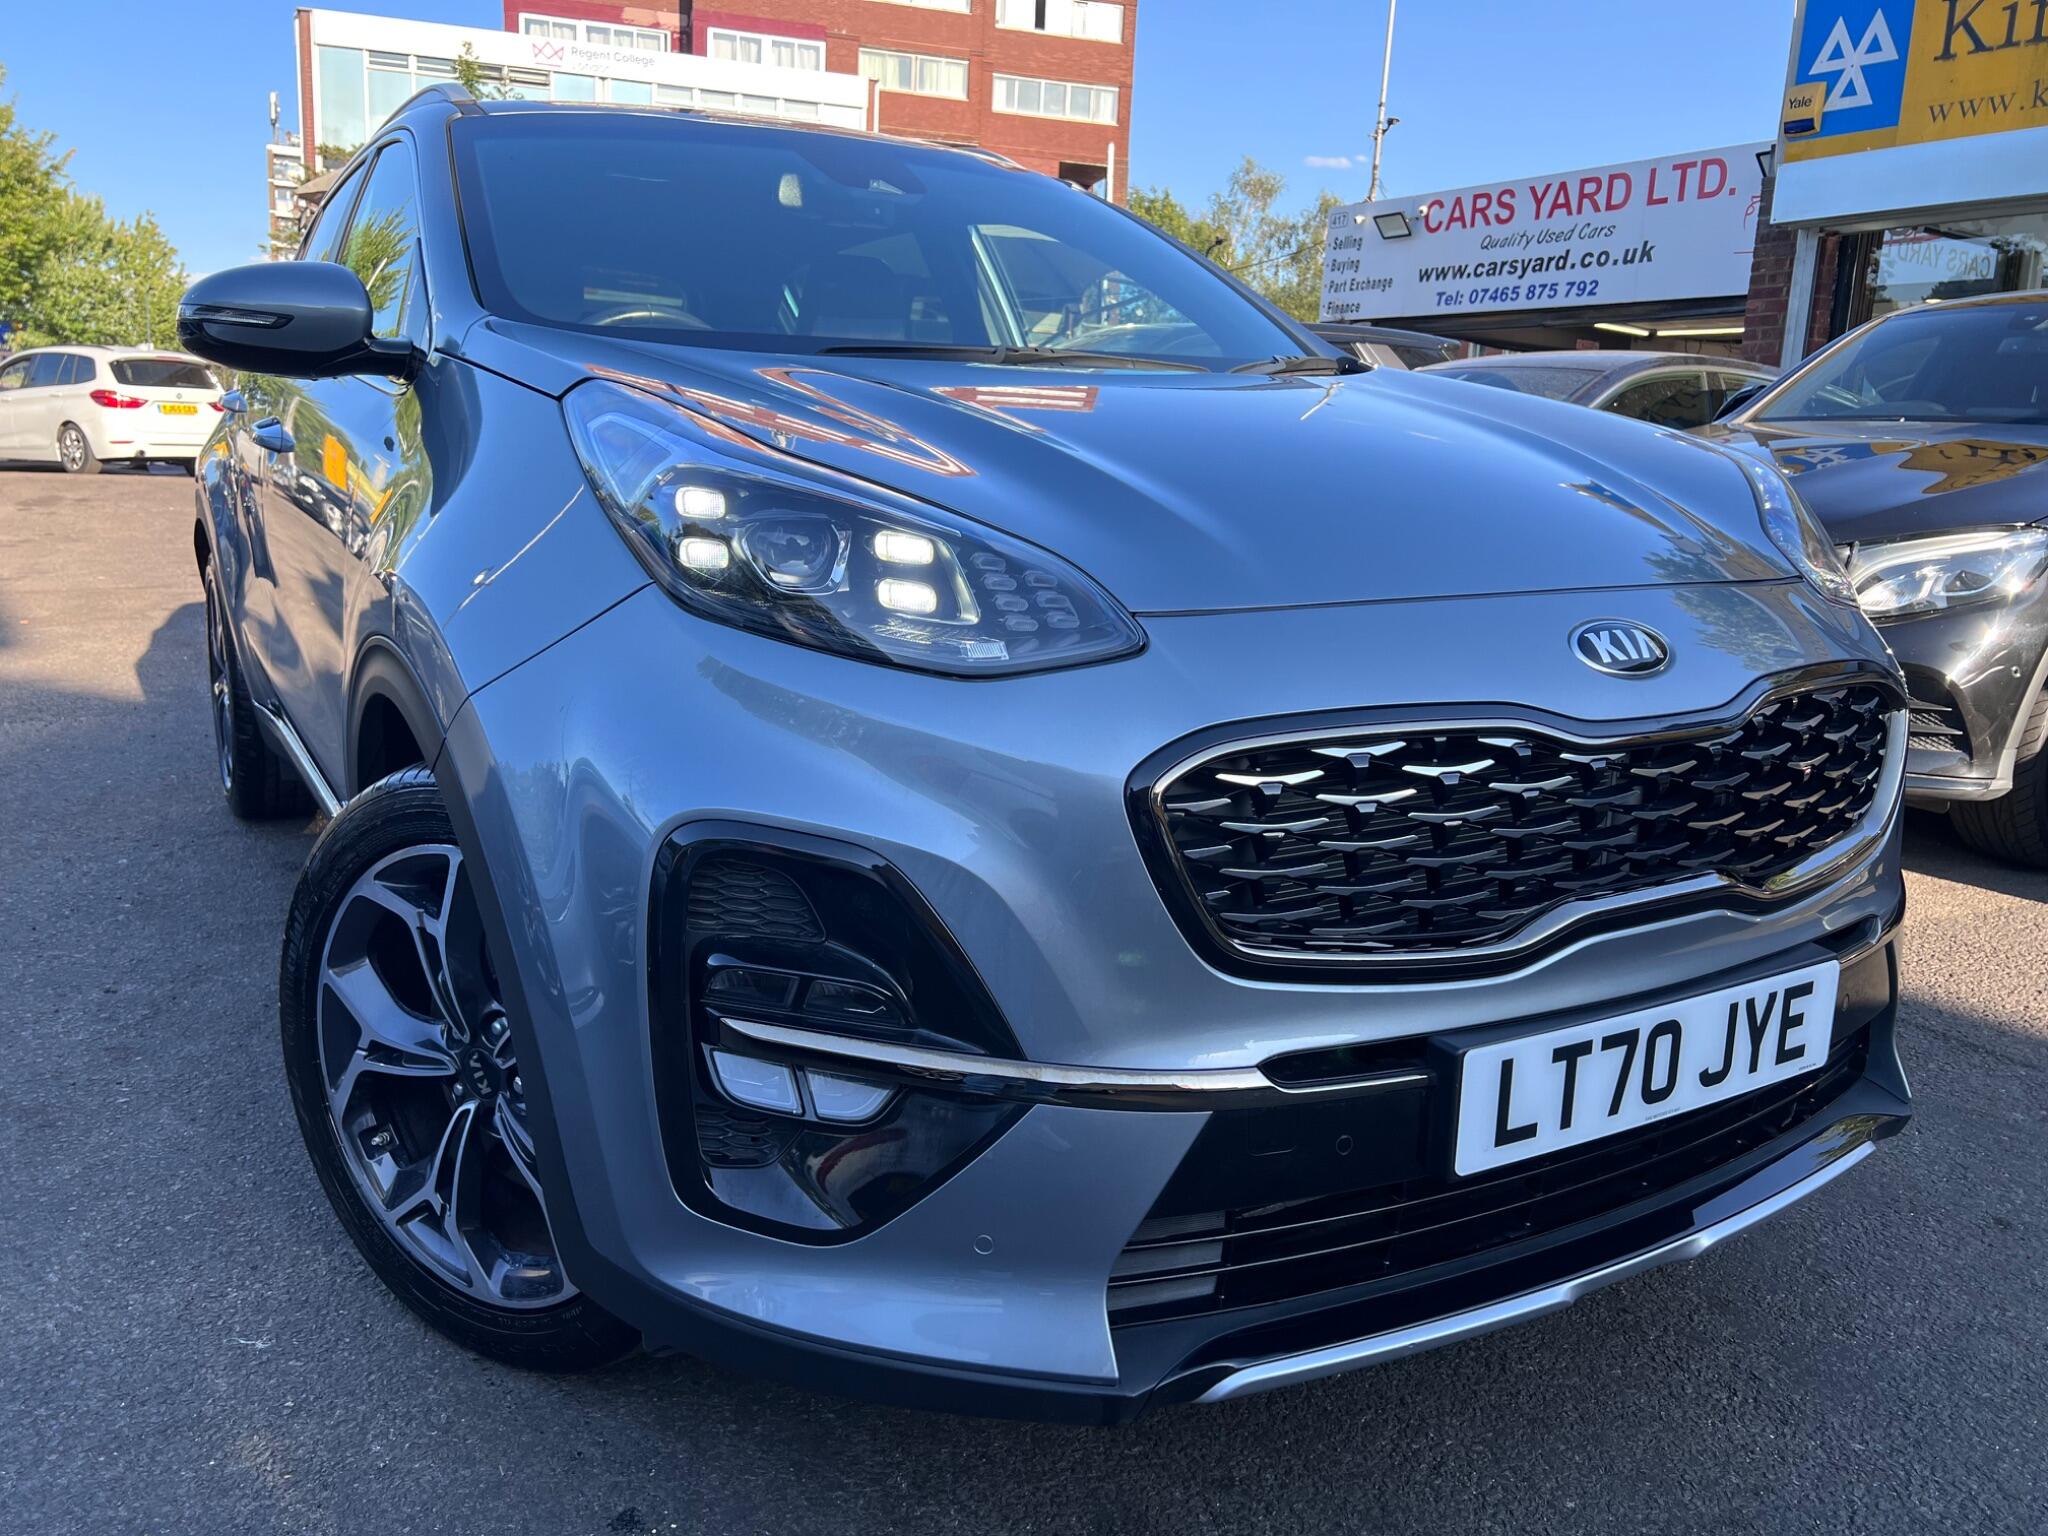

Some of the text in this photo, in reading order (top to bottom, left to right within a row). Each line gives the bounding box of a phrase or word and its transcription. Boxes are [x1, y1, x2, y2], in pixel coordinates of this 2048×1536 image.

[571, 46, 610, 61] Regent
[614, 52, 656, 68] College
[1788, 96, 1812, 110] Yale
[1423, 158, 1737, 234] CARS YARD LTD.
[1333, 235, 1363, 251] Selling
[1480, 222, 1616, 250] Quality Used Cars
[1330, 258, 1360, 275] Buying
[1418, 240, 1656, 283] www.carsyard.co.uk
[1328, 277, 1393, 294] Part Exchange
[1436, 279, 1599, 307] Tel: 07465 875 792
[1326, 301, 1360, 315] Finance
[1584, 629, 1664, 664] KIA
[1493, 980, 1814, 1148] LT70 JYE
